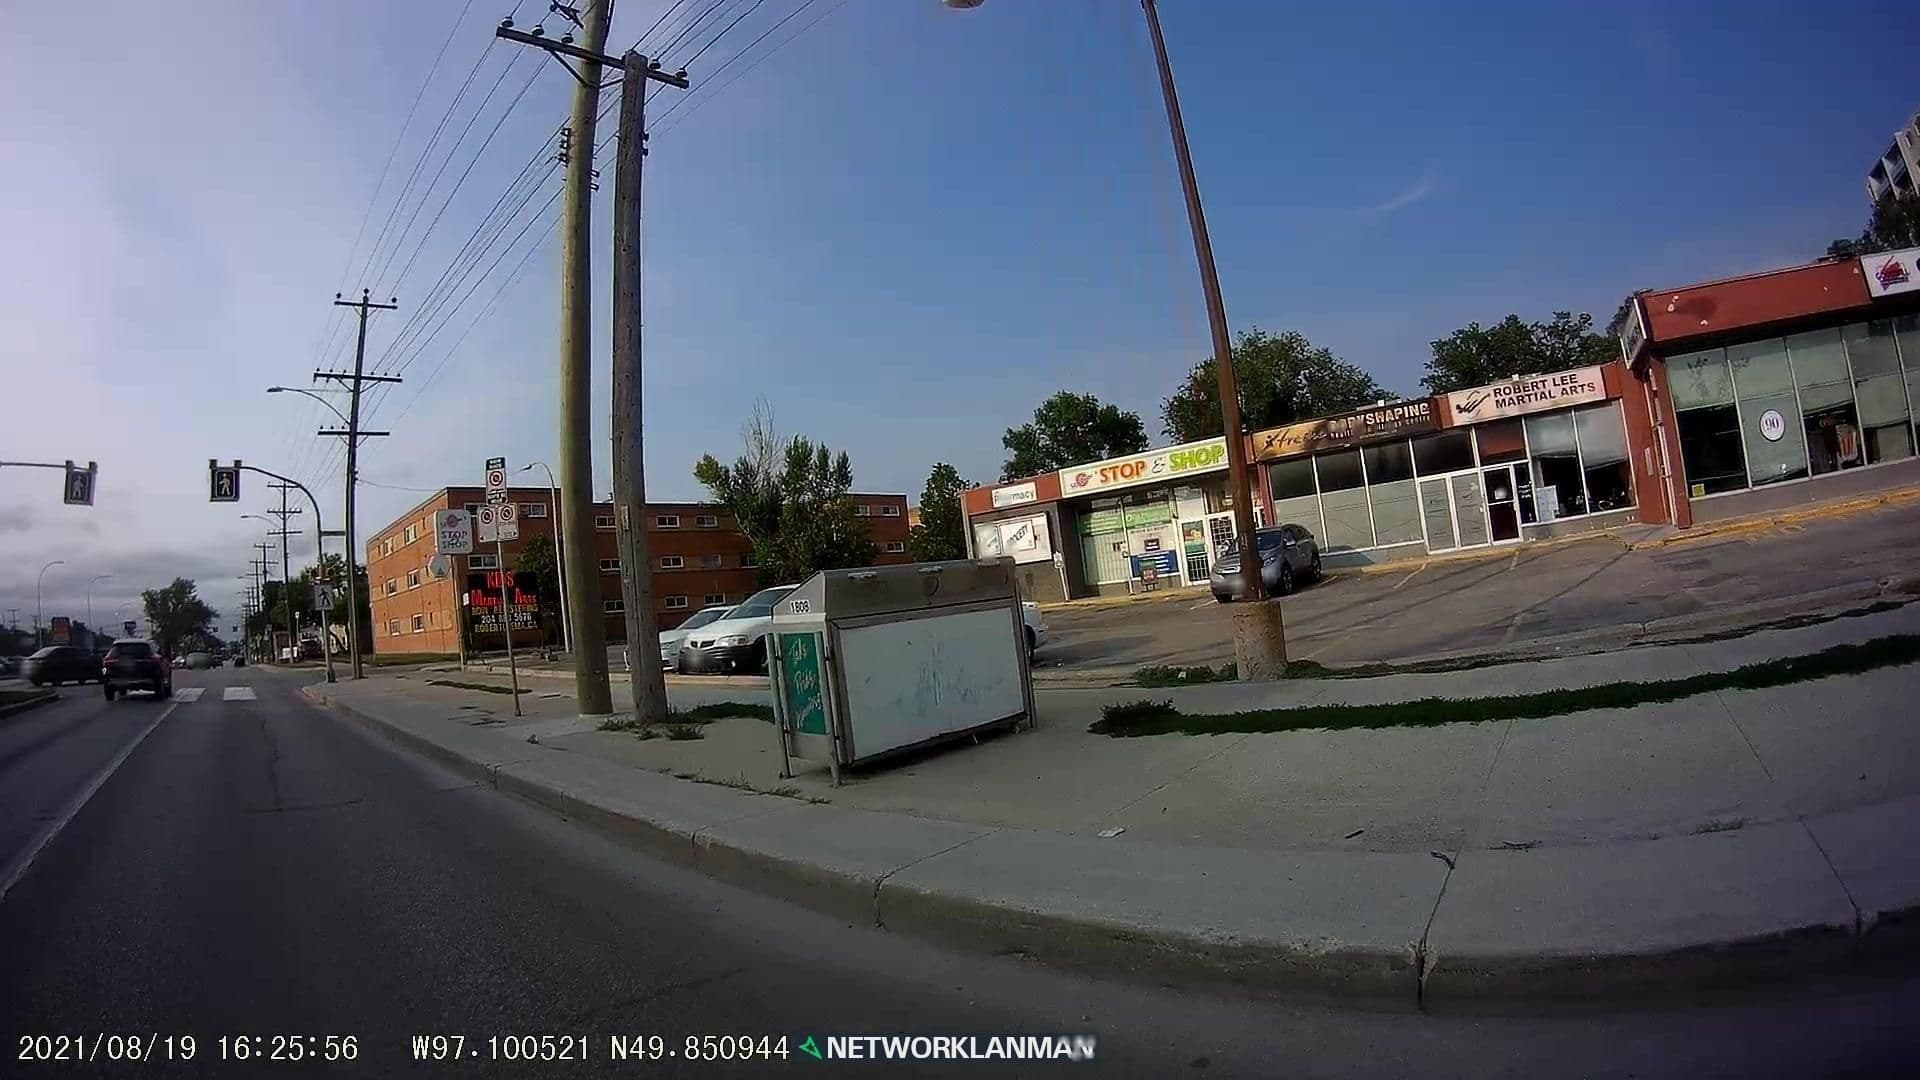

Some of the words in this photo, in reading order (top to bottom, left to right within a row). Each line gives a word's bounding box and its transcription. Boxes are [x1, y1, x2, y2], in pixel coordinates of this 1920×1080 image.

[1494, 379, 1547, 398] ROBERT
[1552, 373, 1578, 387] LEE
[1495, 389, 1556, 409] MARTIAL
[1560, 382, 1596, 398] ARTS
[1764, 417, 1780, 431] 90
[1100, 460, 1146, 483] STOP
[1151, 457, 1165, 474] &
[1169, 445, 1225, 472] SHOP
[442, 530, 468, 540] STOP
